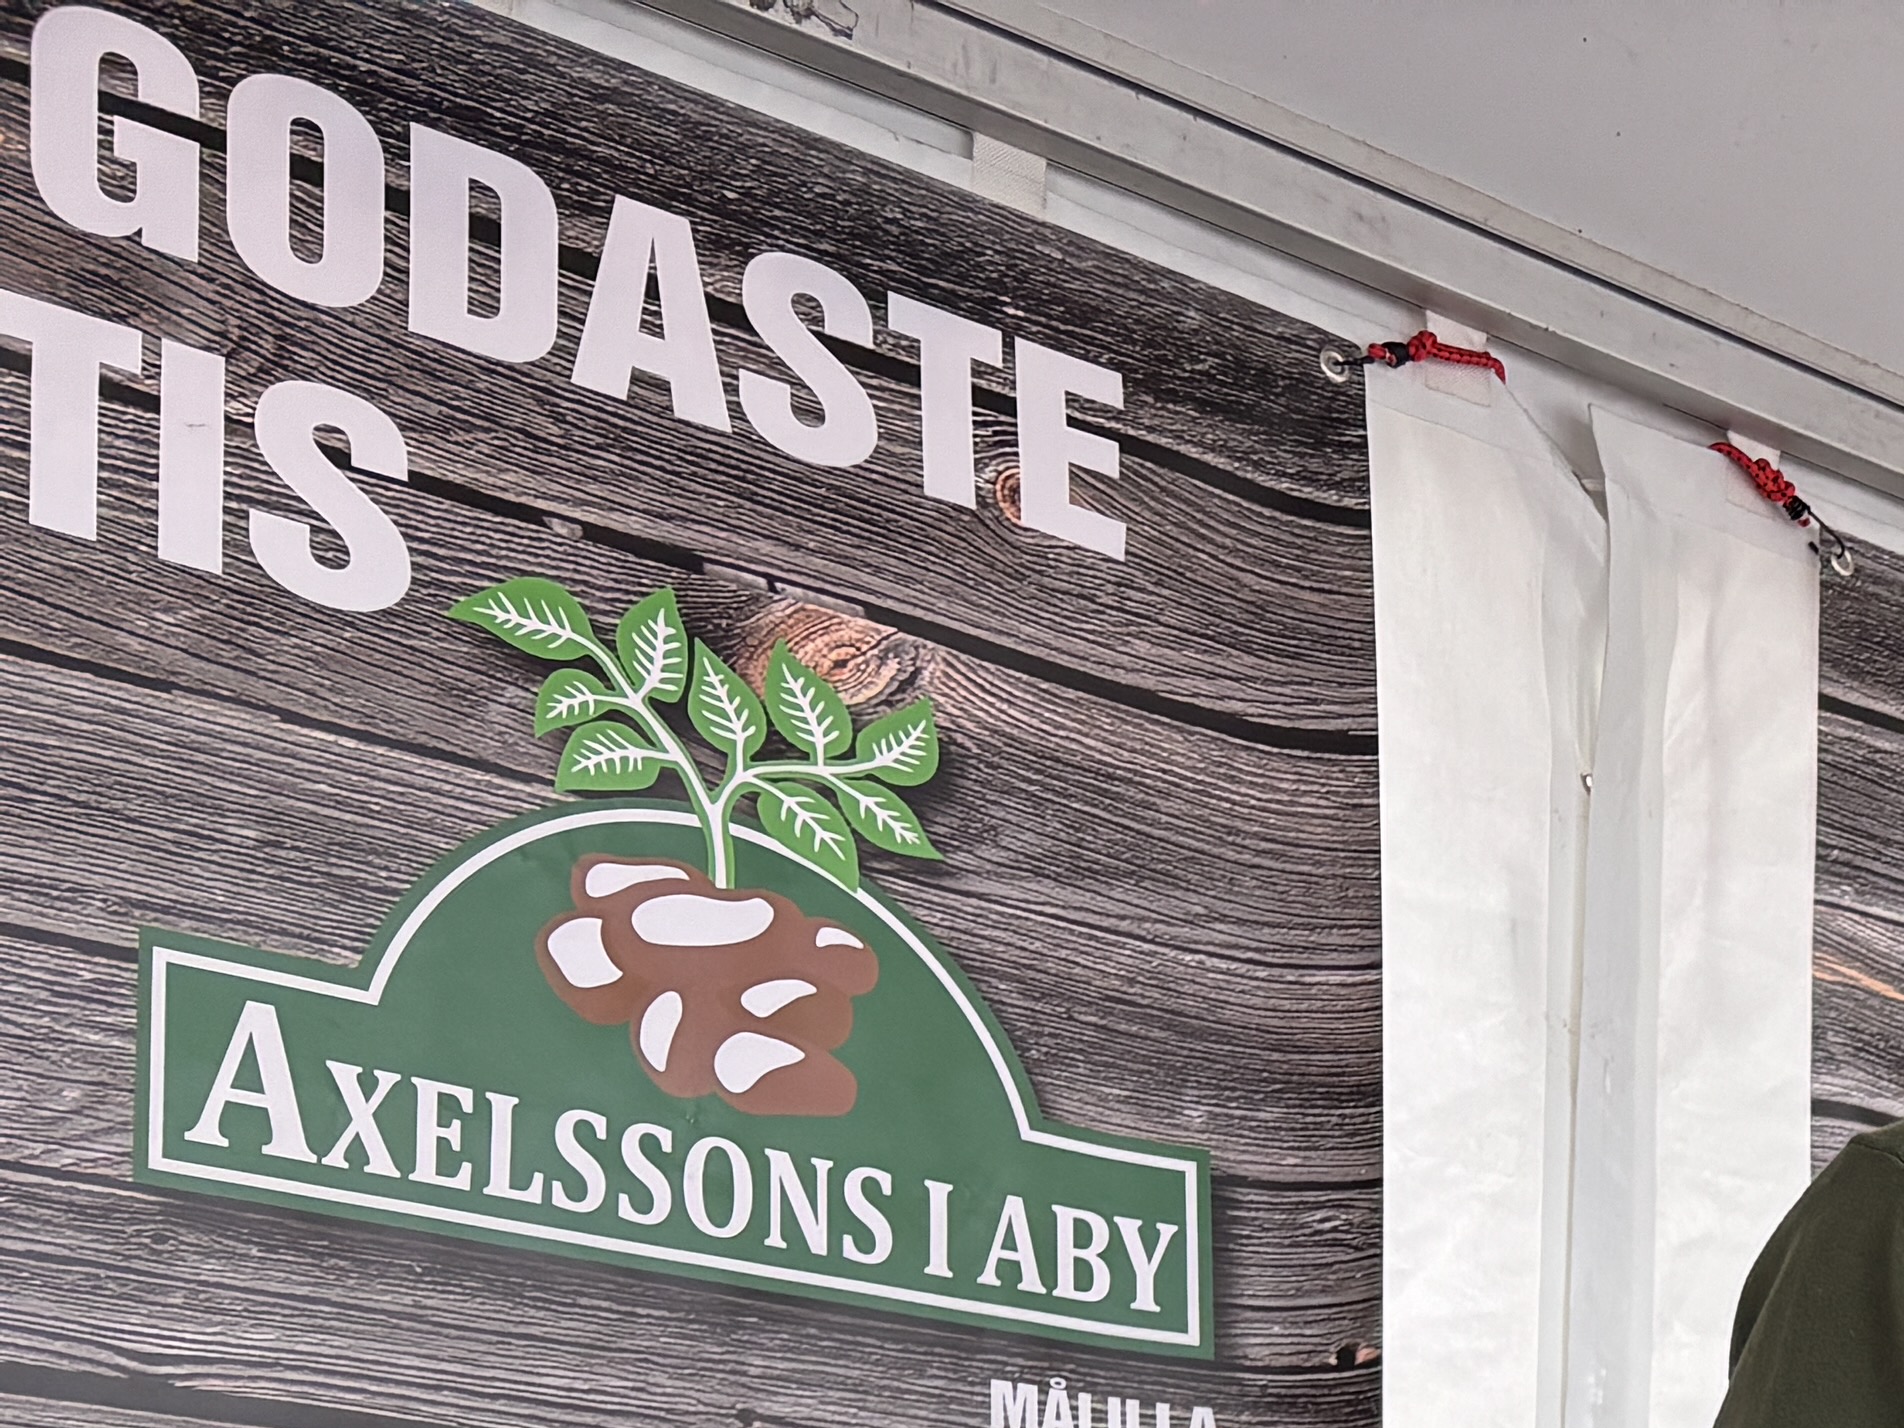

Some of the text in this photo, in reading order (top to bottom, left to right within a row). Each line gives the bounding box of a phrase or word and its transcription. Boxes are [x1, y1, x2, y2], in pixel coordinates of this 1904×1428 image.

[30, 5, 1128, 562] GODASTE
[184, 999, 1180, 1314] AXELSSONS I ABY
